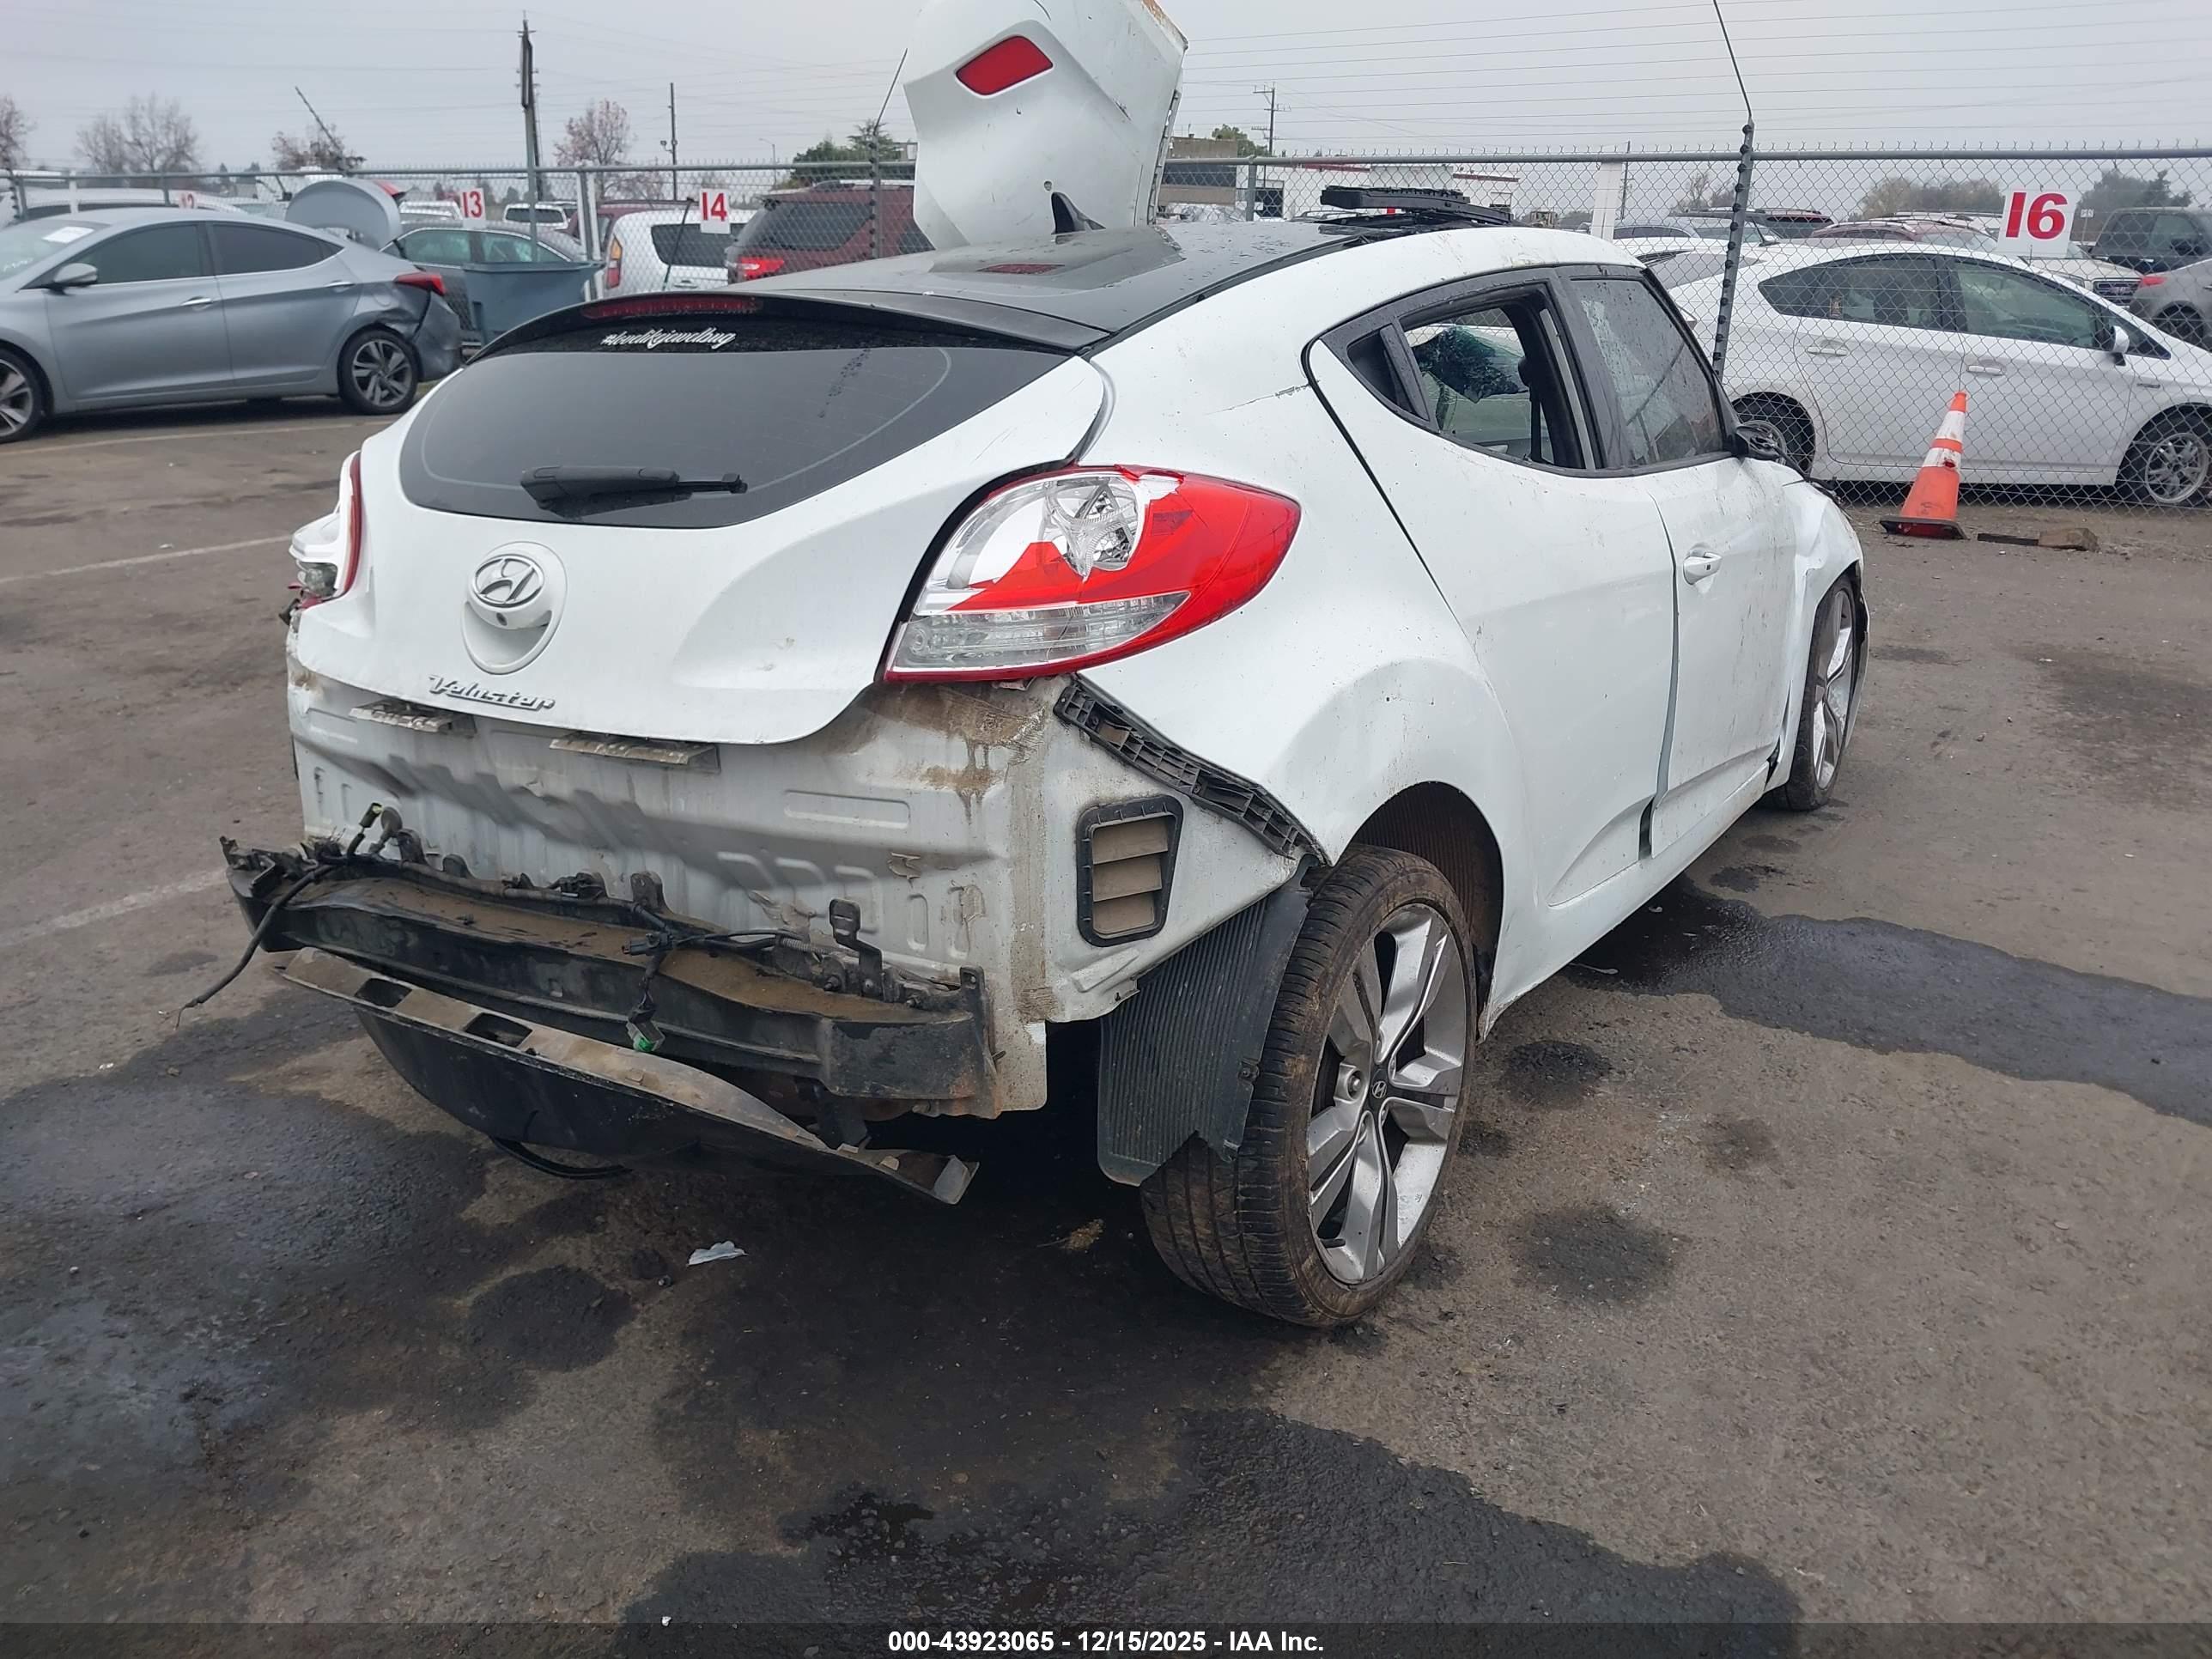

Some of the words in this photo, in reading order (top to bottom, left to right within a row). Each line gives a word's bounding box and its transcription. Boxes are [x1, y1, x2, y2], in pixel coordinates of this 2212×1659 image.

[463, 191, 483, 218] 13
[702, 191, 726, 222] 14
[2005, 191, 2068, 240] 16
[428, 675, 556, 712] Veloster
